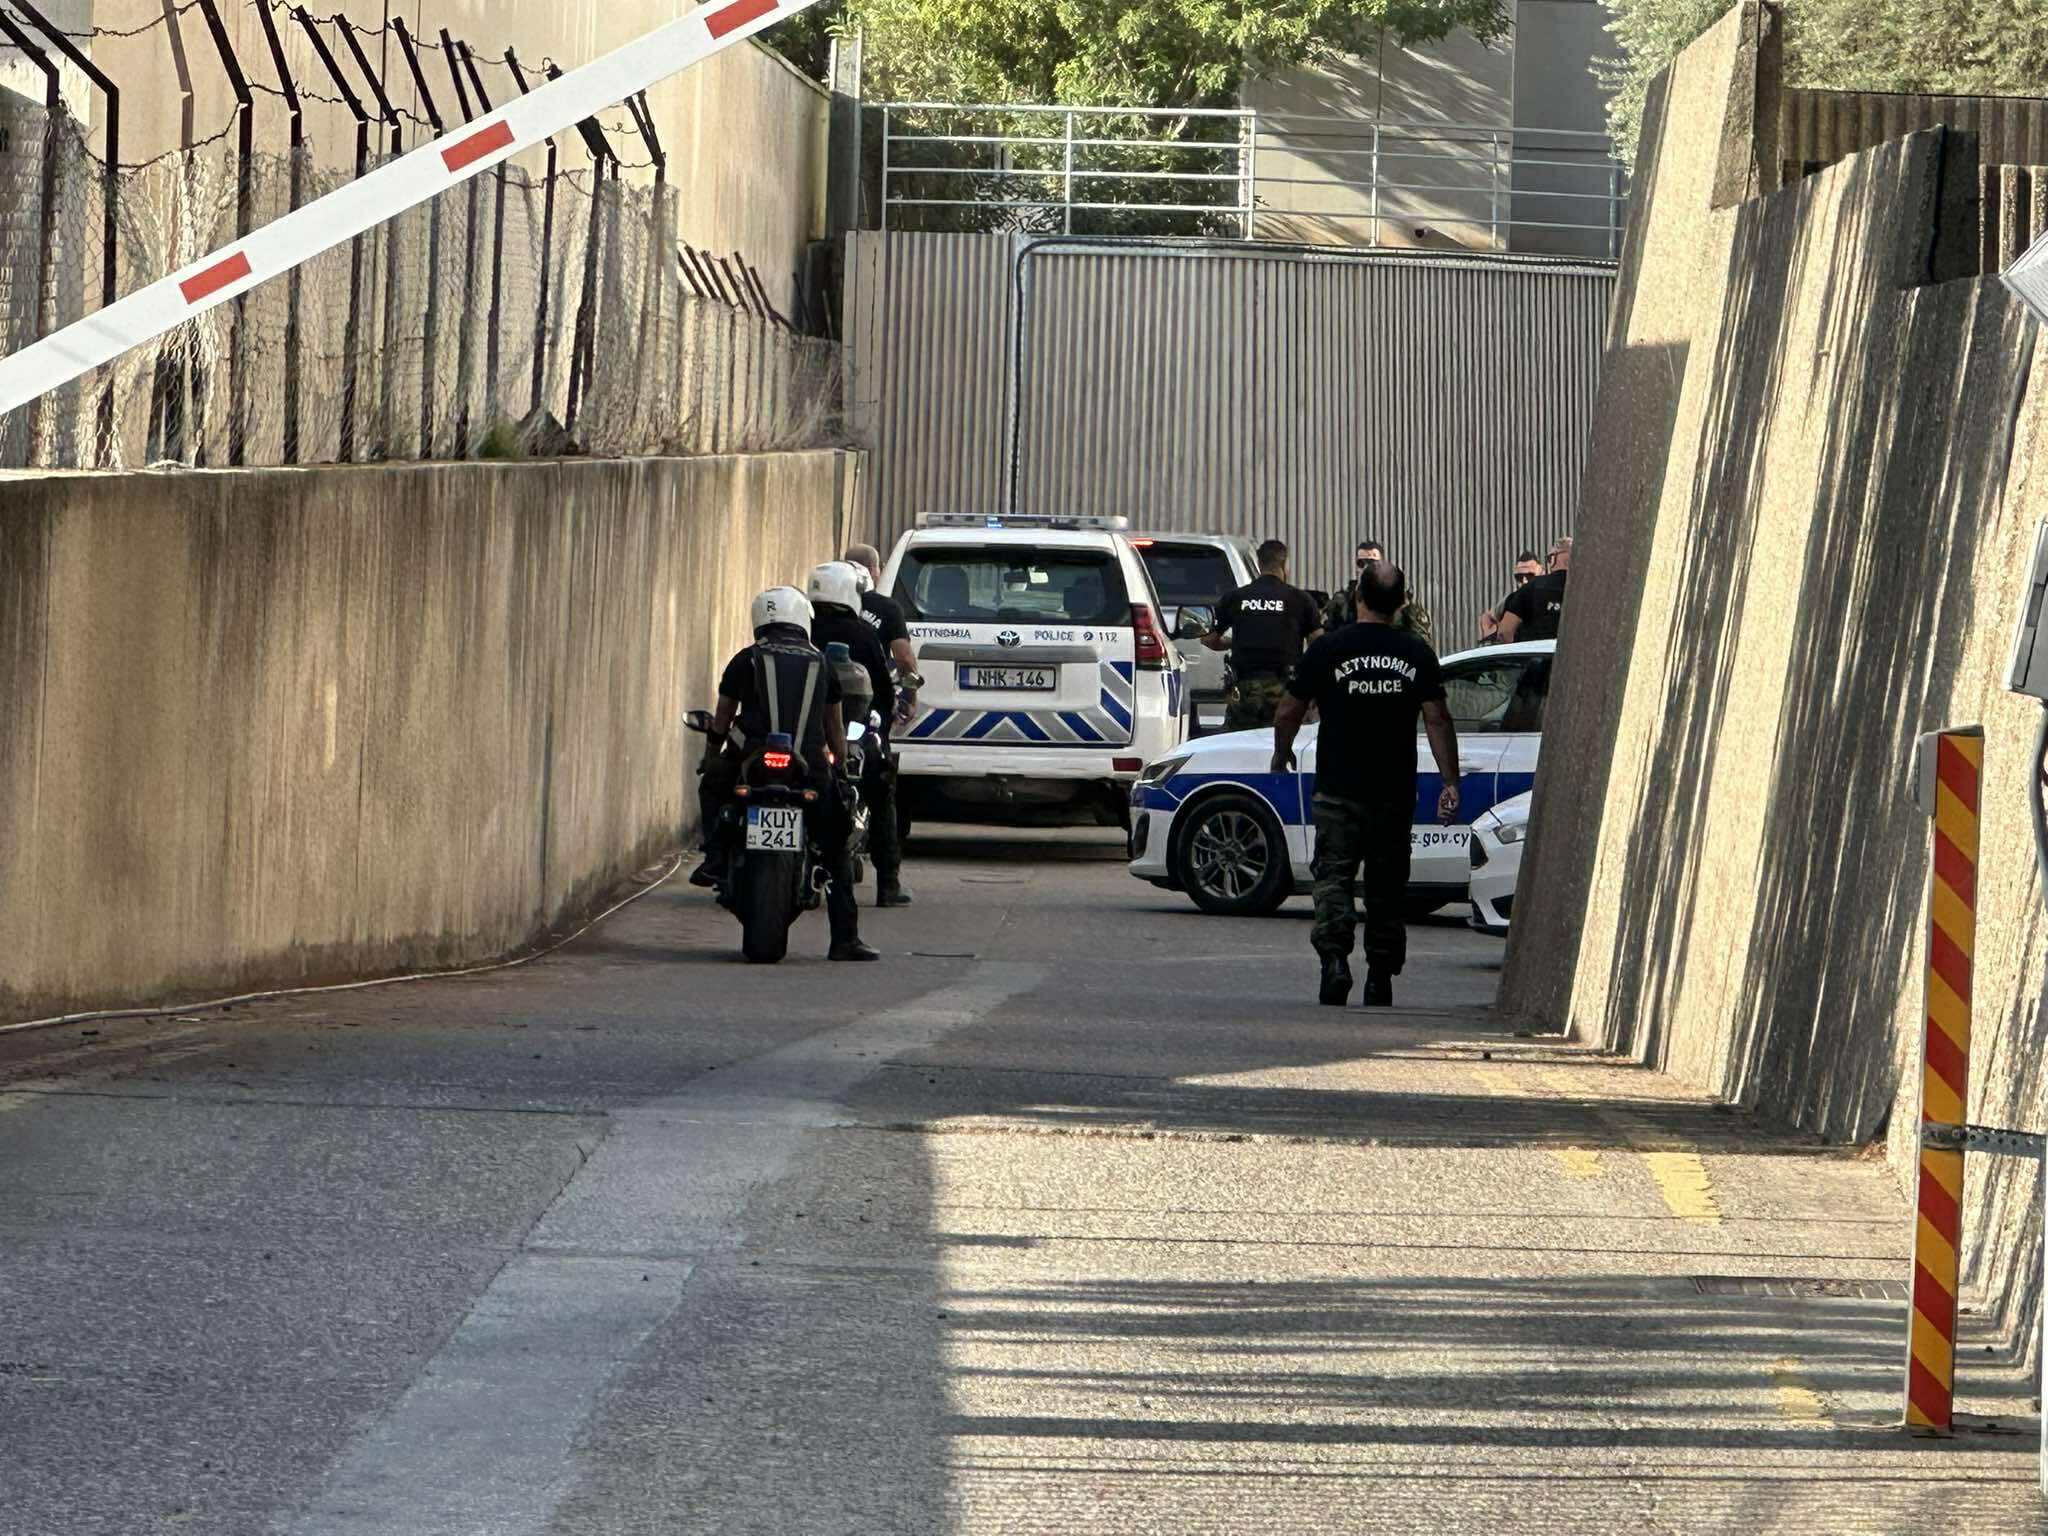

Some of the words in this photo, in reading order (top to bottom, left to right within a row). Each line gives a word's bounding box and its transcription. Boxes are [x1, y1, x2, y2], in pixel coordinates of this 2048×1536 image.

[1241, 599, 1284, 612] POLICE
[1034, 630, 1074, 641] POLICE
[1098, 631, 1118, 643] 112
[977, 669, 1007, 688] NHK
[1016, 671, 1045, 687] 146
[1348, 679, 1402, 694] POLICE
[761, 810, 798, 829] KUY
[761, 830, 797, 849] 241
